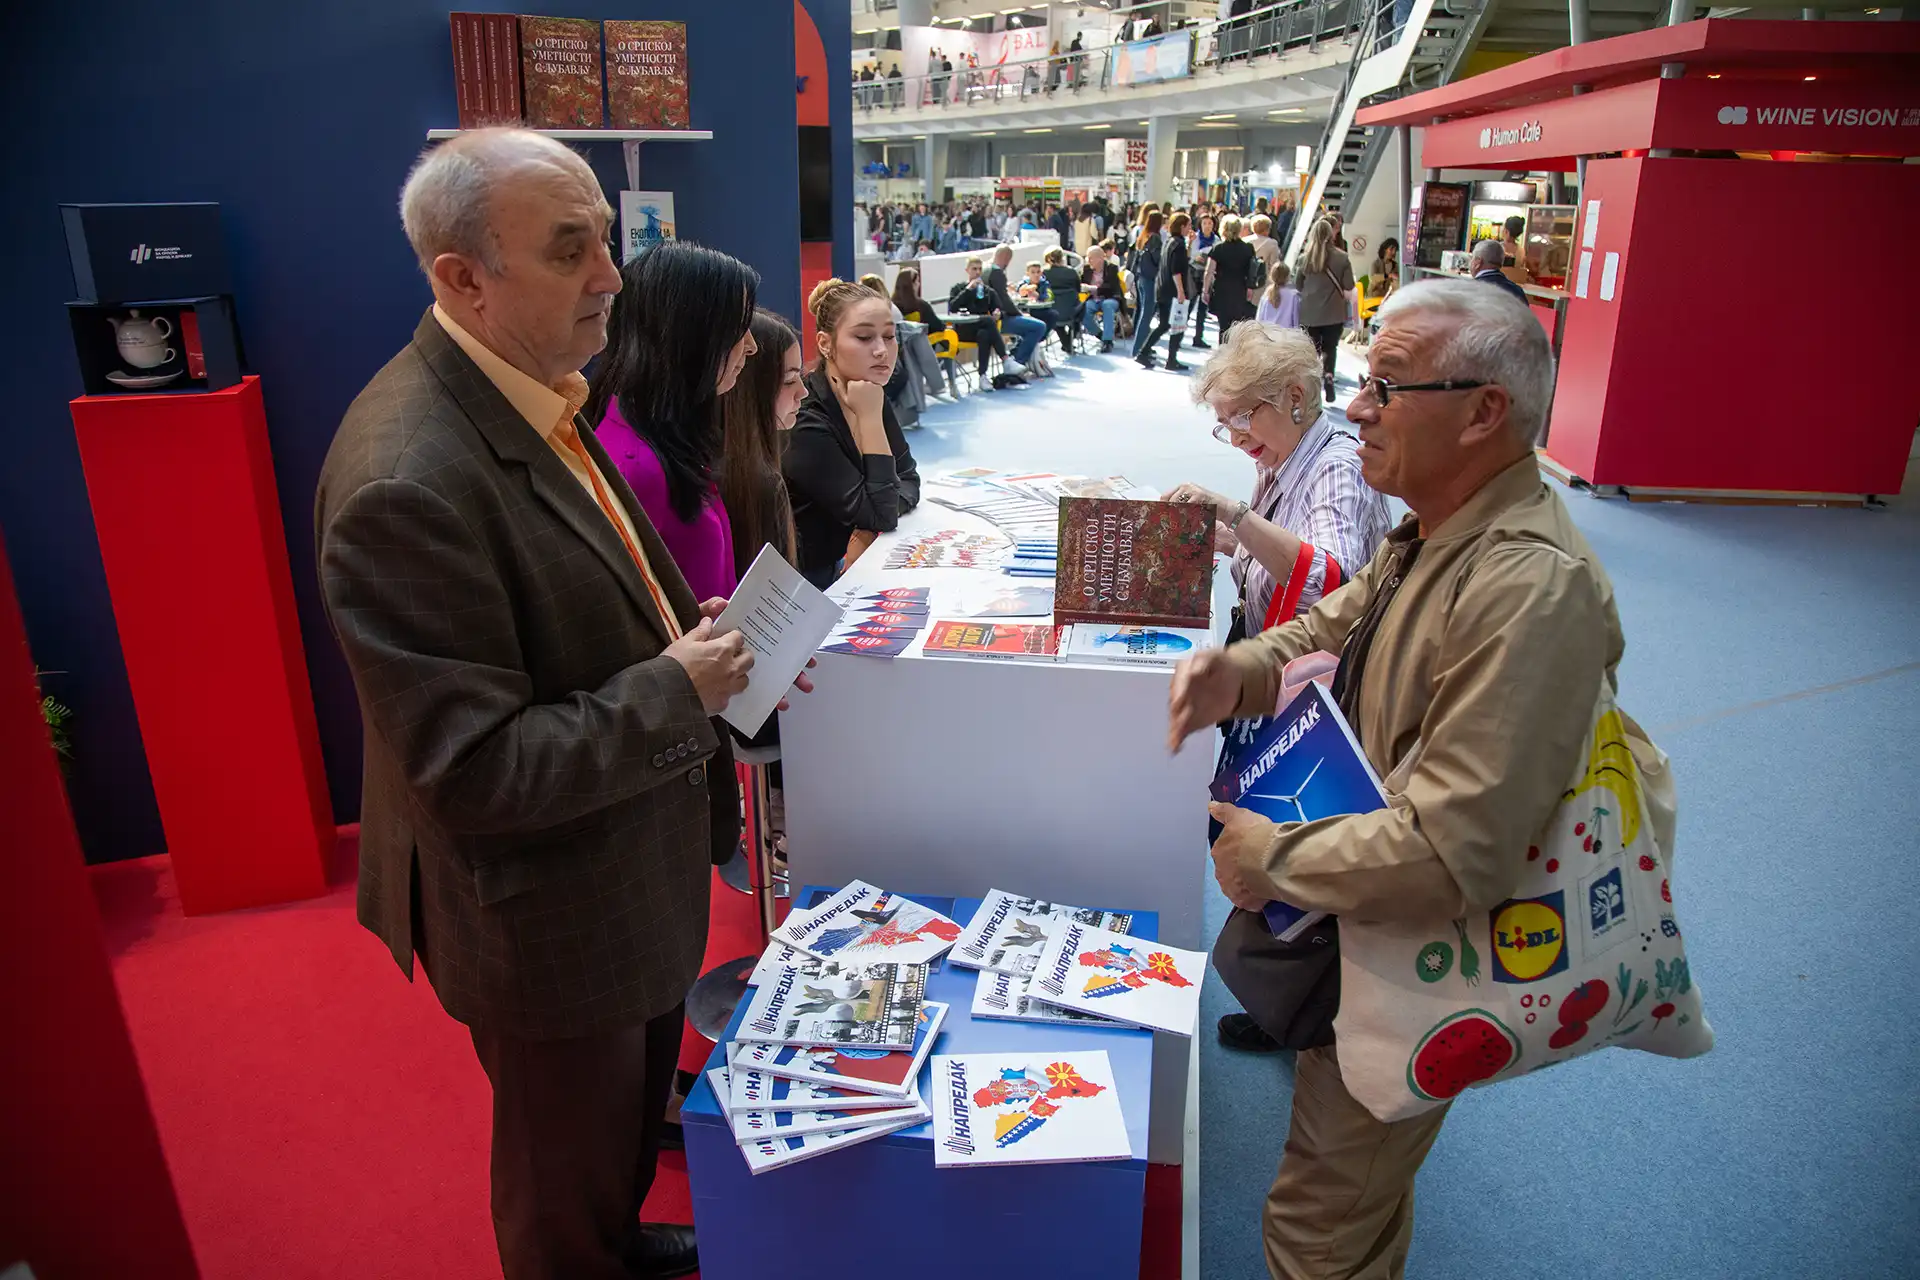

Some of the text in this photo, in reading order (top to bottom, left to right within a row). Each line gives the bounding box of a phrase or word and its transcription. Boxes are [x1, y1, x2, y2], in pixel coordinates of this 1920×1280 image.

[532, 50, 592, 63] УМЕТНОСТИ
[544, 38, 589, 50] СРПСКОЈ
[615, 53, 676, 64] УМЕТНОСТИ
[627, 41, 672, 52] СРПСКОЈ
[1492, 127, 1519, 147] Human
[1756, 107, 1816, 126] WINE
[1823, 107, 1899, 126] VISION
[1084, 518, 1099, 583] СРПСКОЈ
[1100, 513, 1117, 602] УМЕТНОСТИ
[1240, 701, 1320, 793] НАПРЕДАК
[803, 887, 870, 933] НАПРЕДАК
[975, 896, 1014, 949] НАПРЕДАК
[1052, 924, 1084, 986] НАПРЕДАК
[764, 965, 798, 1022] НАПРЕДАК
[950, 1059, 971, 1139] НАПРЕДАК
